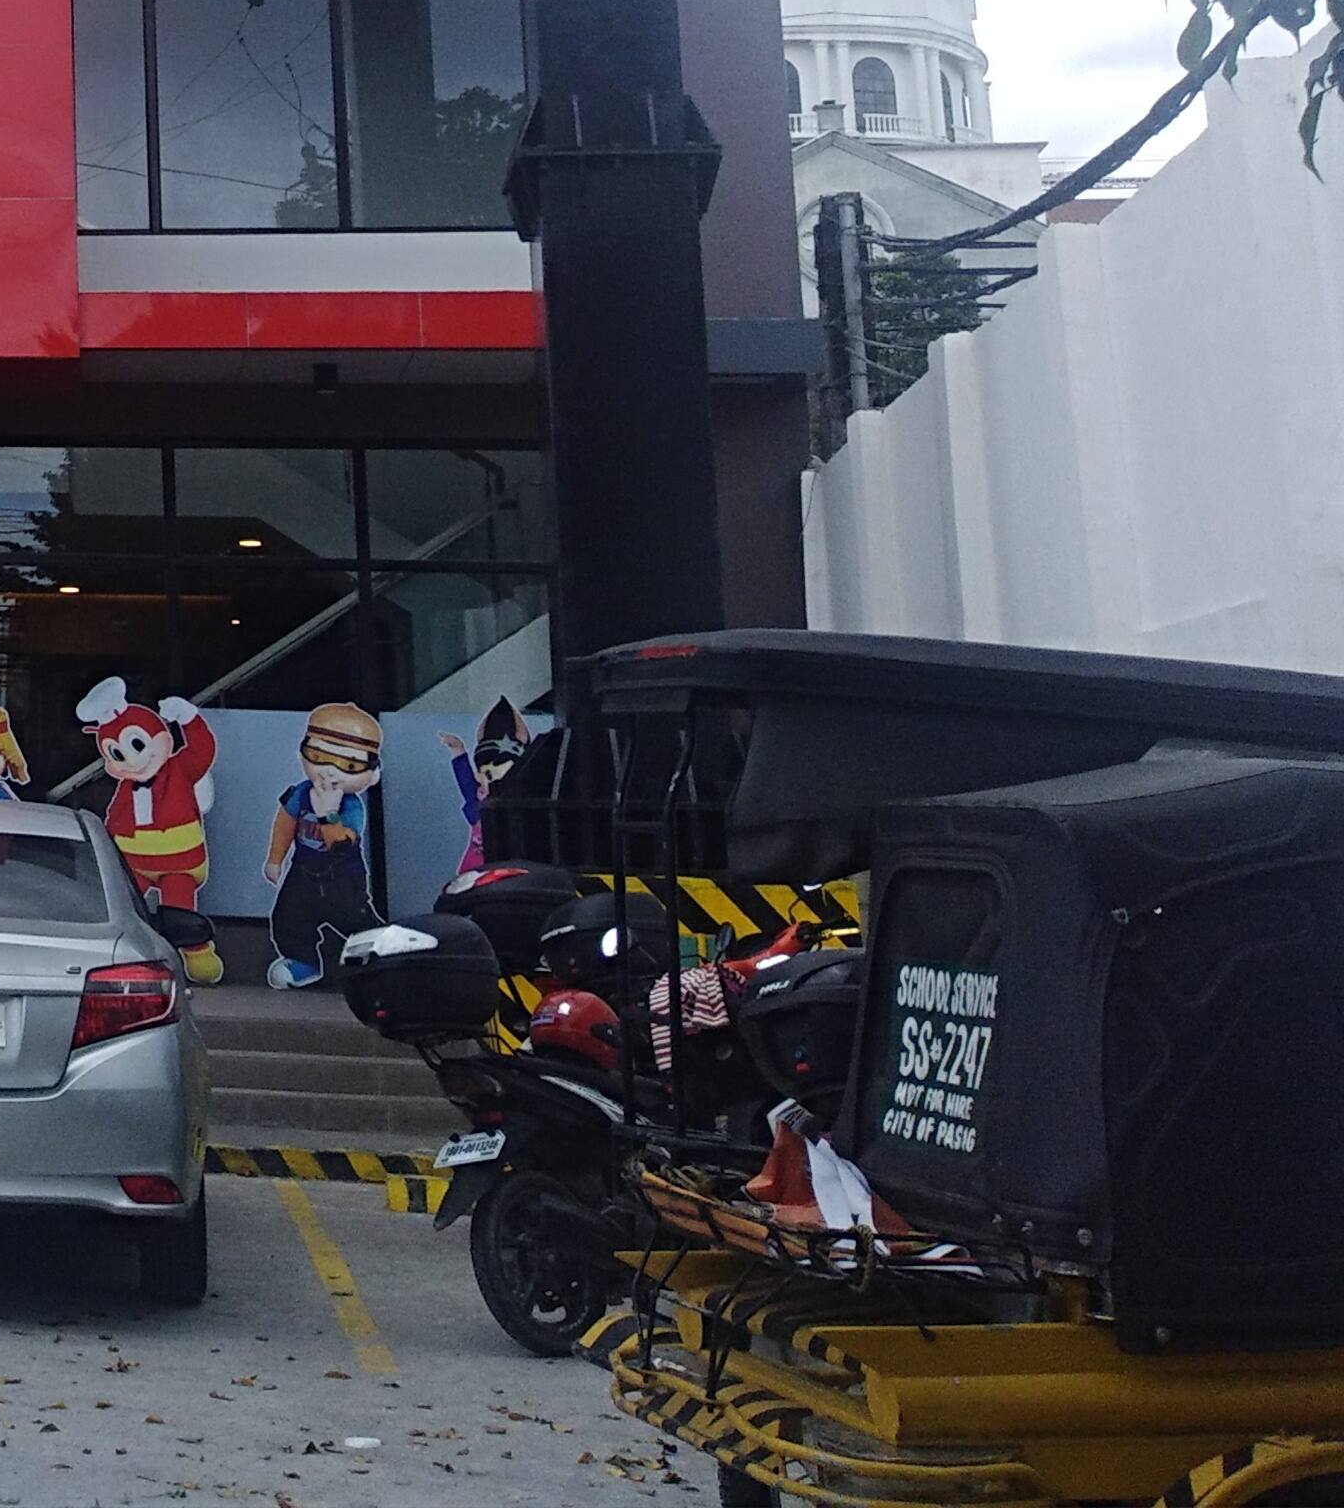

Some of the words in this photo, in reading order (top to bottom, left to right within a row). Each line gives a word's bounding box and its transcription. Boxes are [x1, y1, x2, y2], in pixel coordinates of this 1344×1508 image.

[897, 965, 951, 1014] SCHOOL
[951, 972, 999, 1019] SERVICE
[894, 1081, 924, 1108] NOT
[924, 1088, 945, 1113] FOR
[945, 1092, 974, 1121] HIRE
[883, 1107, 916, 1139] CITY
[916, 1116, 936, 1142] OF
[936, 1120, 977, 1153] PASIG
